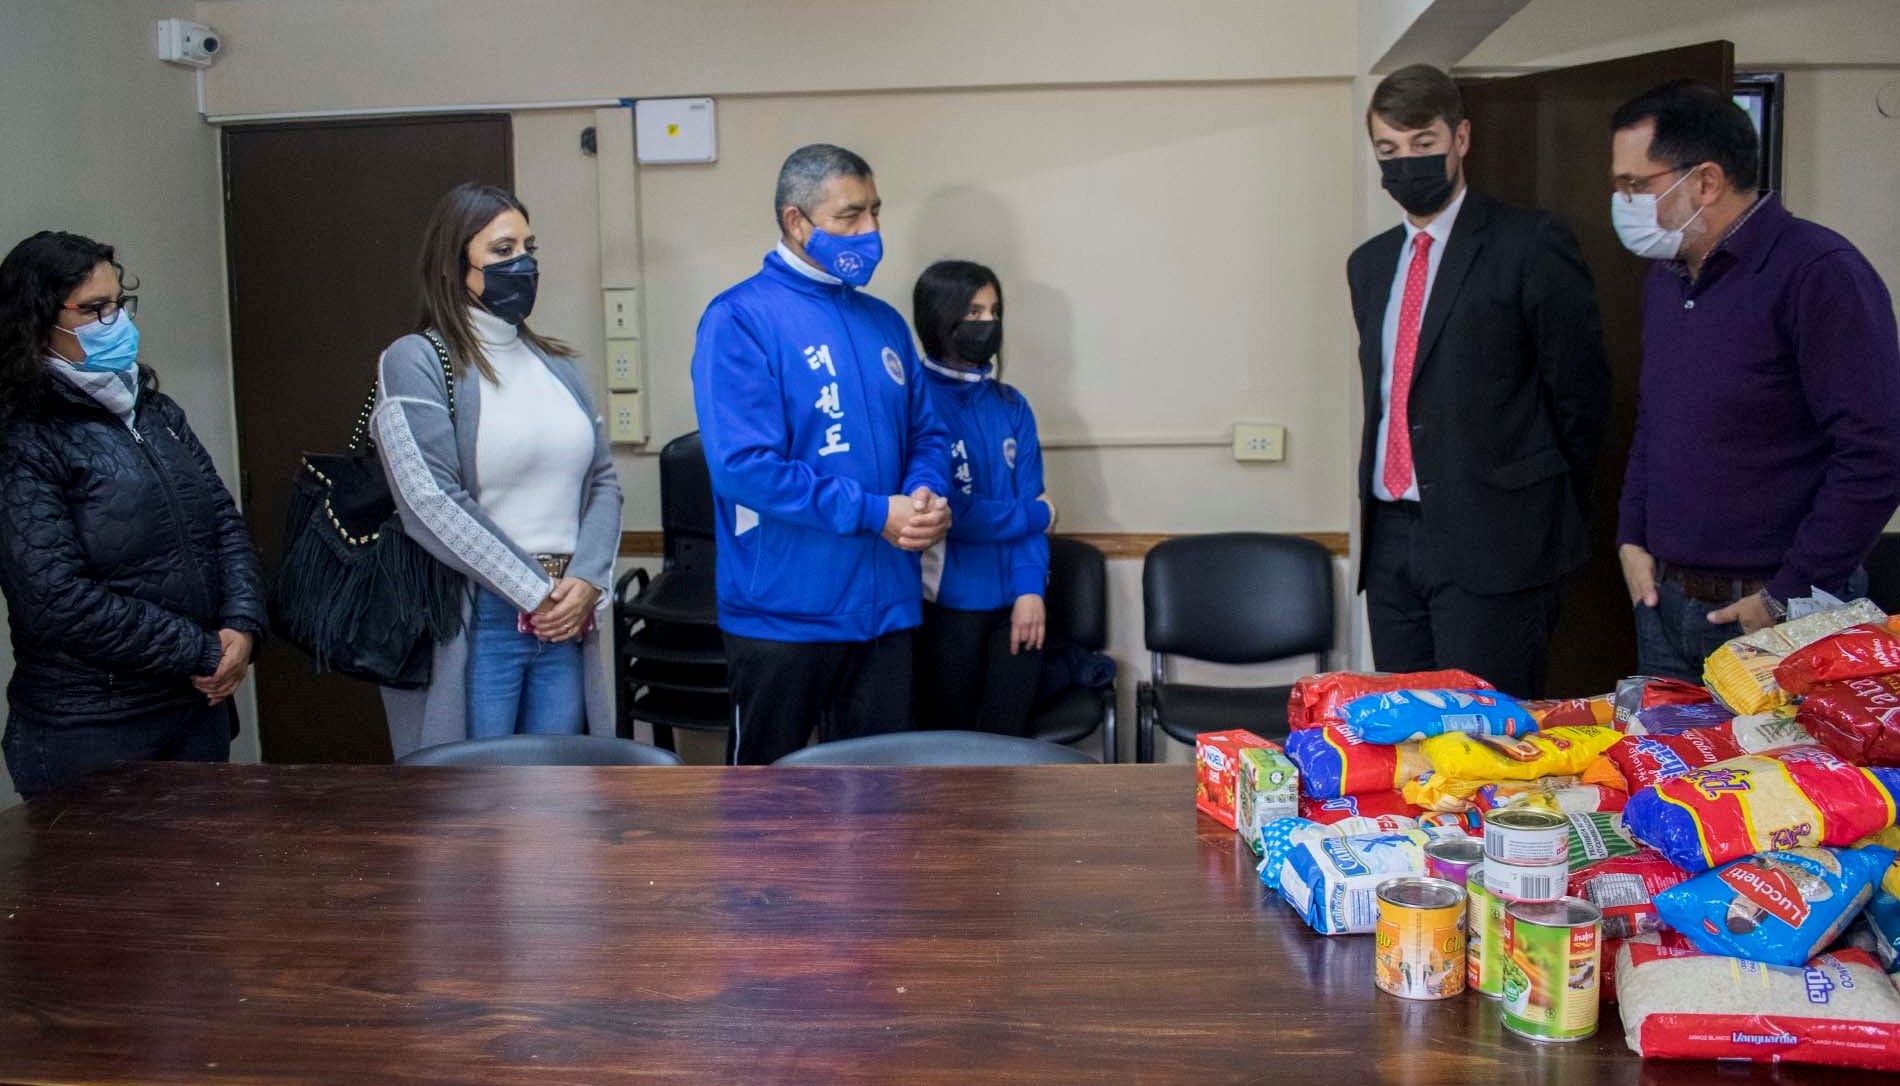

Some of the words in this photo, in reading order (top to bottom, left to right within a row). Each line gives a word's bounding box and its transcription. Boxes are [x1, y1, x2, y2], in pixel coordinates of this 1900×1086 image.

[1207, 751, 1223, 767] NOEL
[1726, 868, 1801, 920] Lucchetti
[1732, 1031, 1798, 1045] Vanguardia
